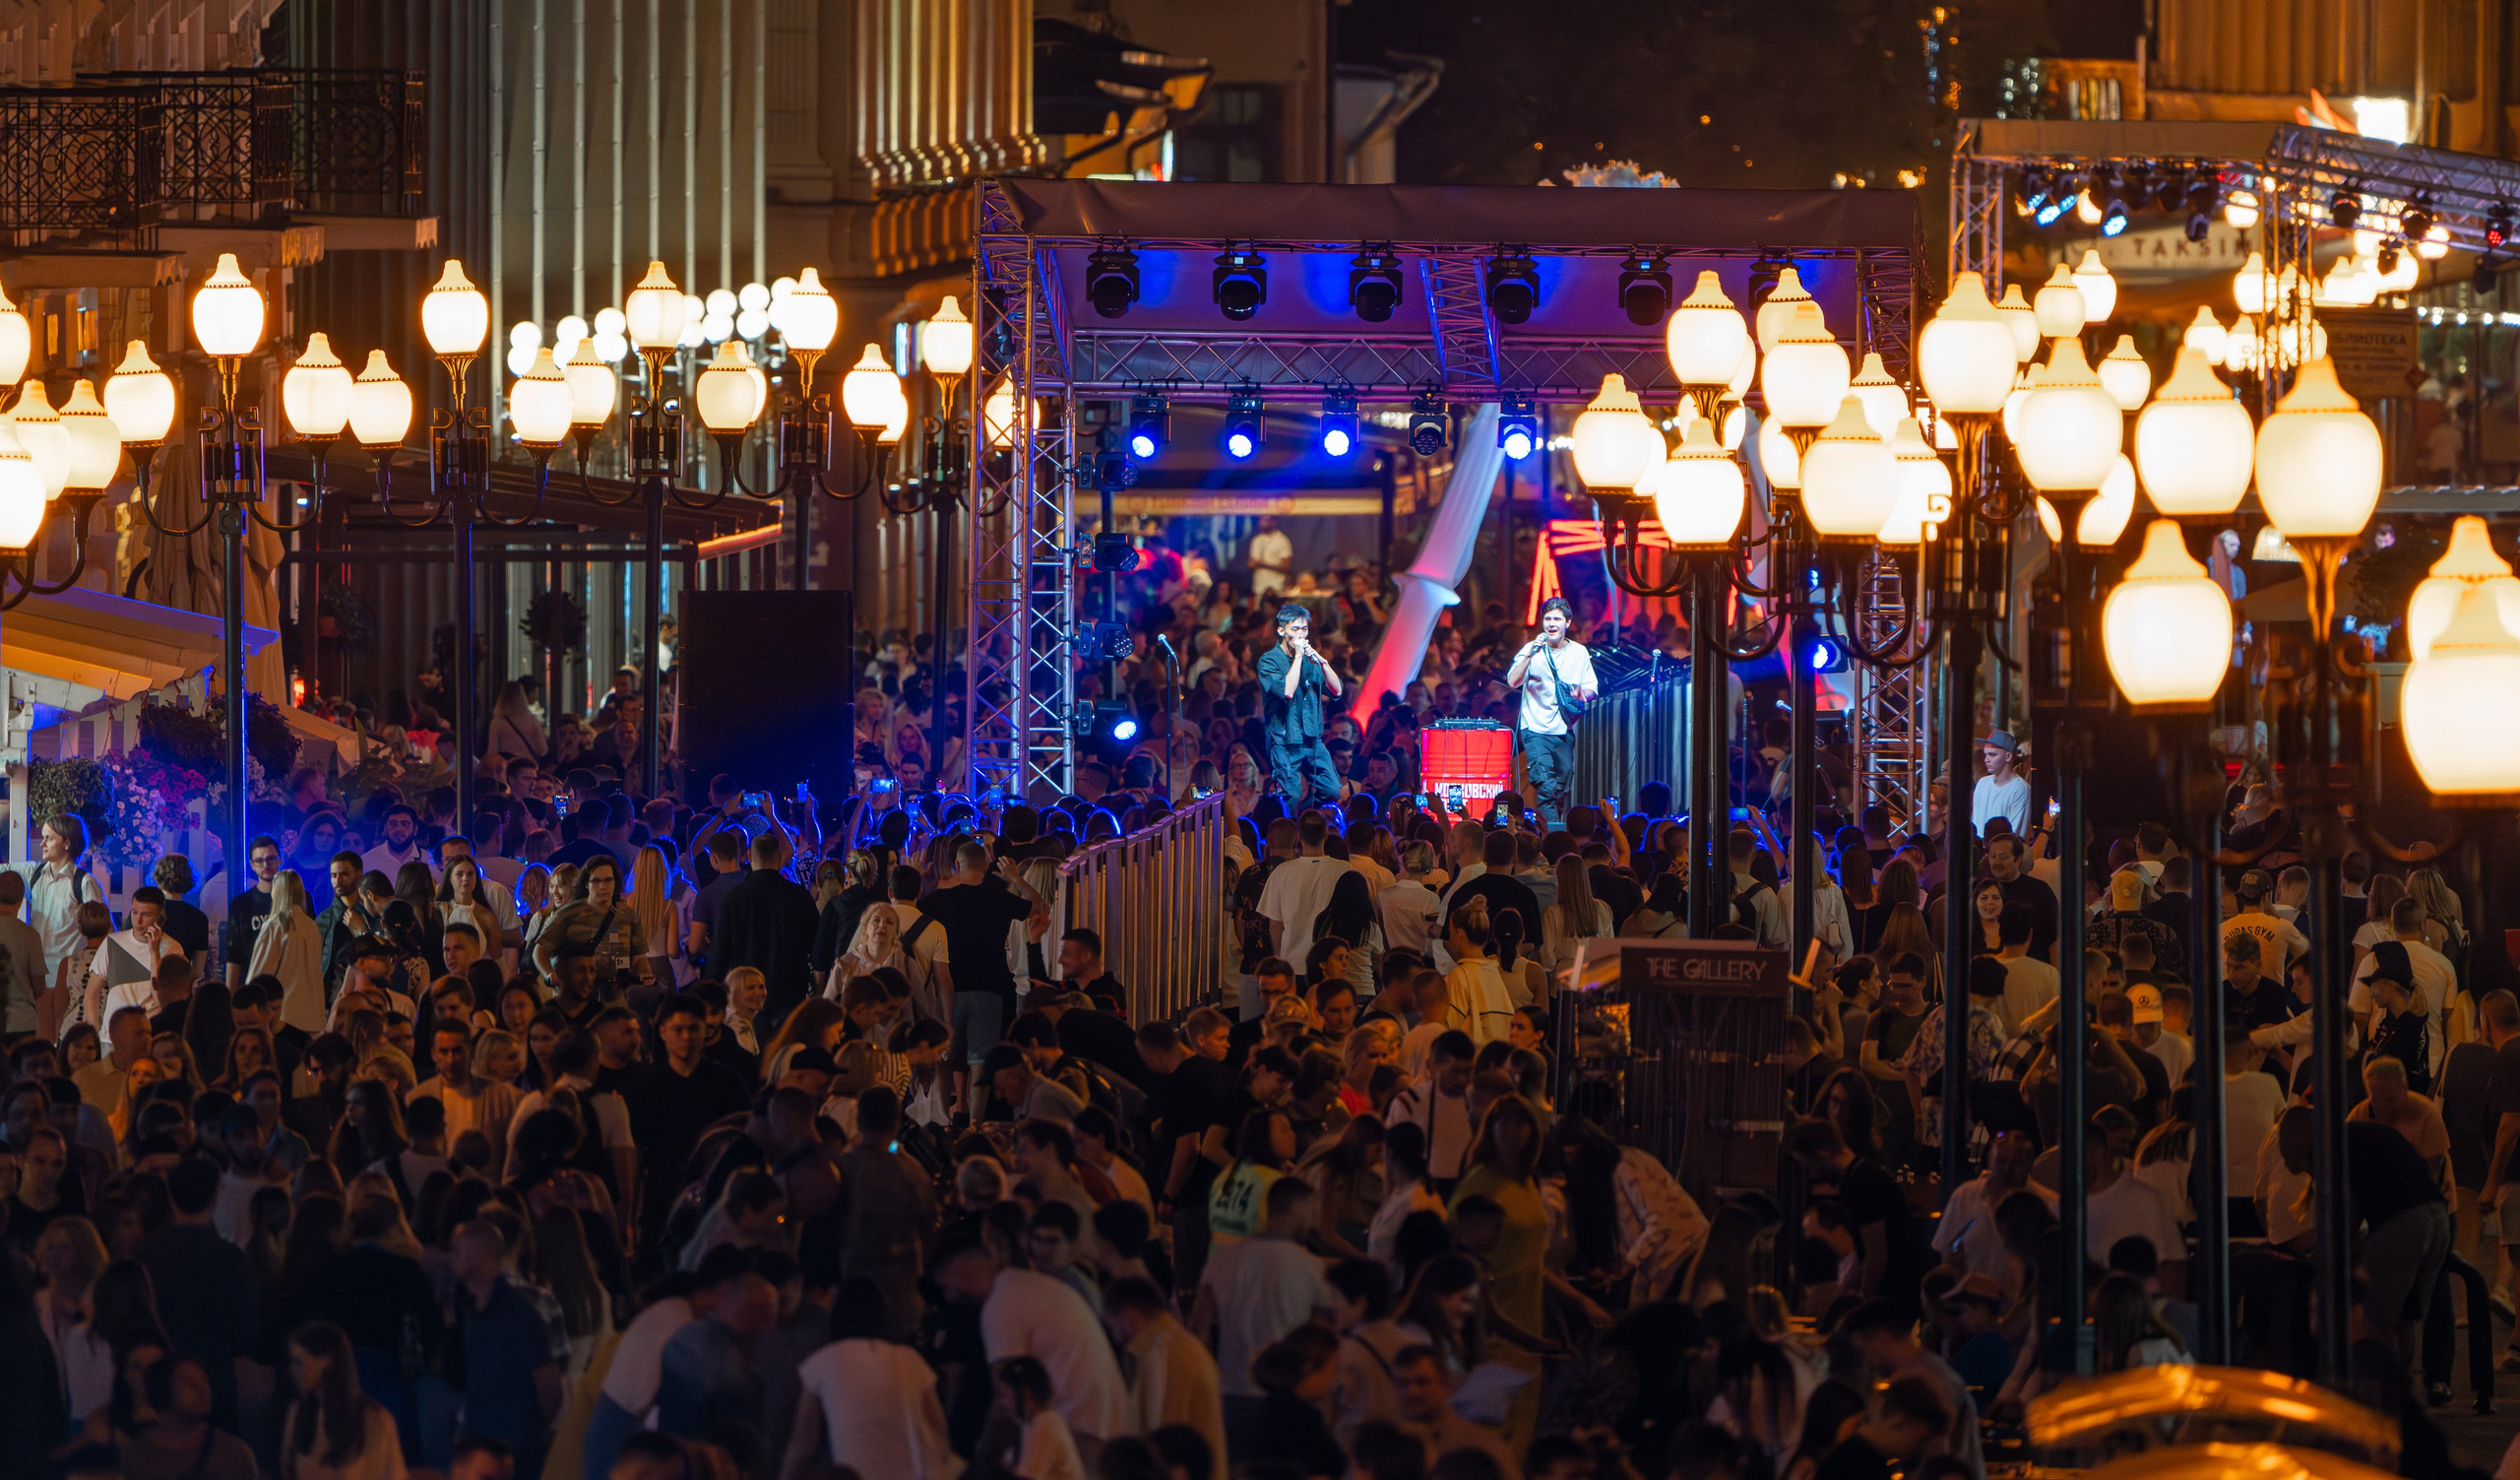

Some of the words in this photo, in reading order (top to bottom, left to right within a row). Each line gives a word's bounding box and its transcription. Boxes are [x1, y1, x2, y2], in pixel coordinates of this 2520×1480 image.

[1434, 781, 1504, 799] МОКОВСКИЙ
[2254, 925, 2276, 942] GYM
[1646, 957, 1677, 979] THE
[1683, 958, 1767, 981] GALLERY
